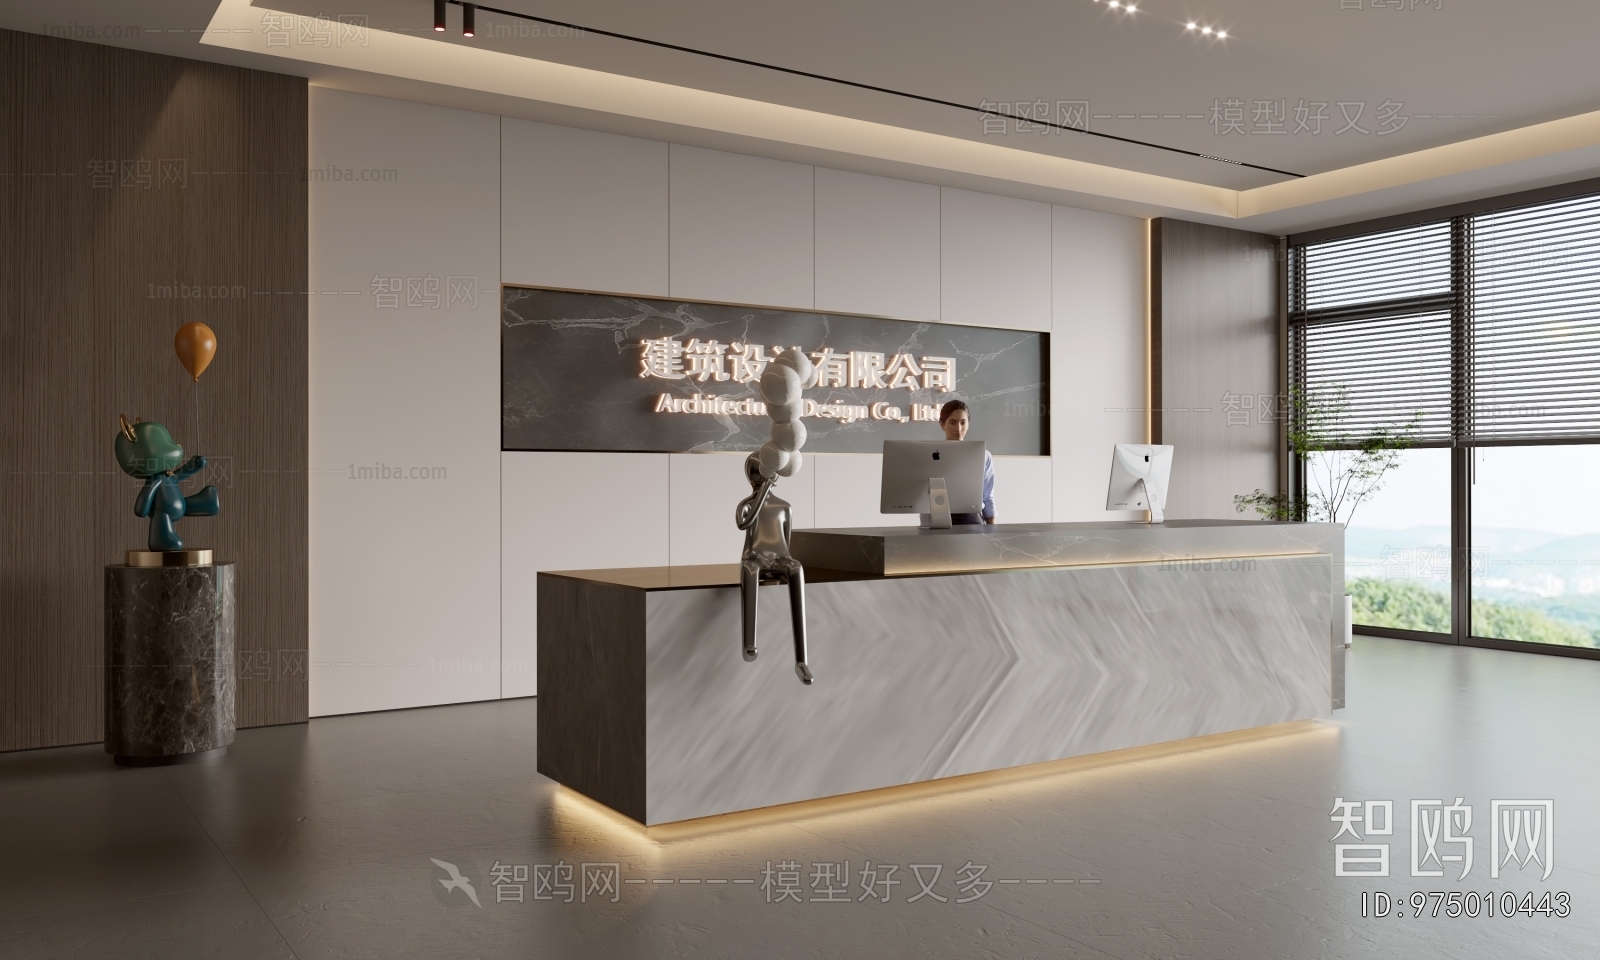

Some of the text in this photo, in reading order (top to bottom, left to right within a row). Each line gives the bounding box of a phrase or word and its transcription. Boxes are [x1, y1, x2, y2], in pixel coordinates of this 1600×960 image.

[638, 336, 957, 393] 建筑设有限公司
[799, 398, 869, 424] Design
